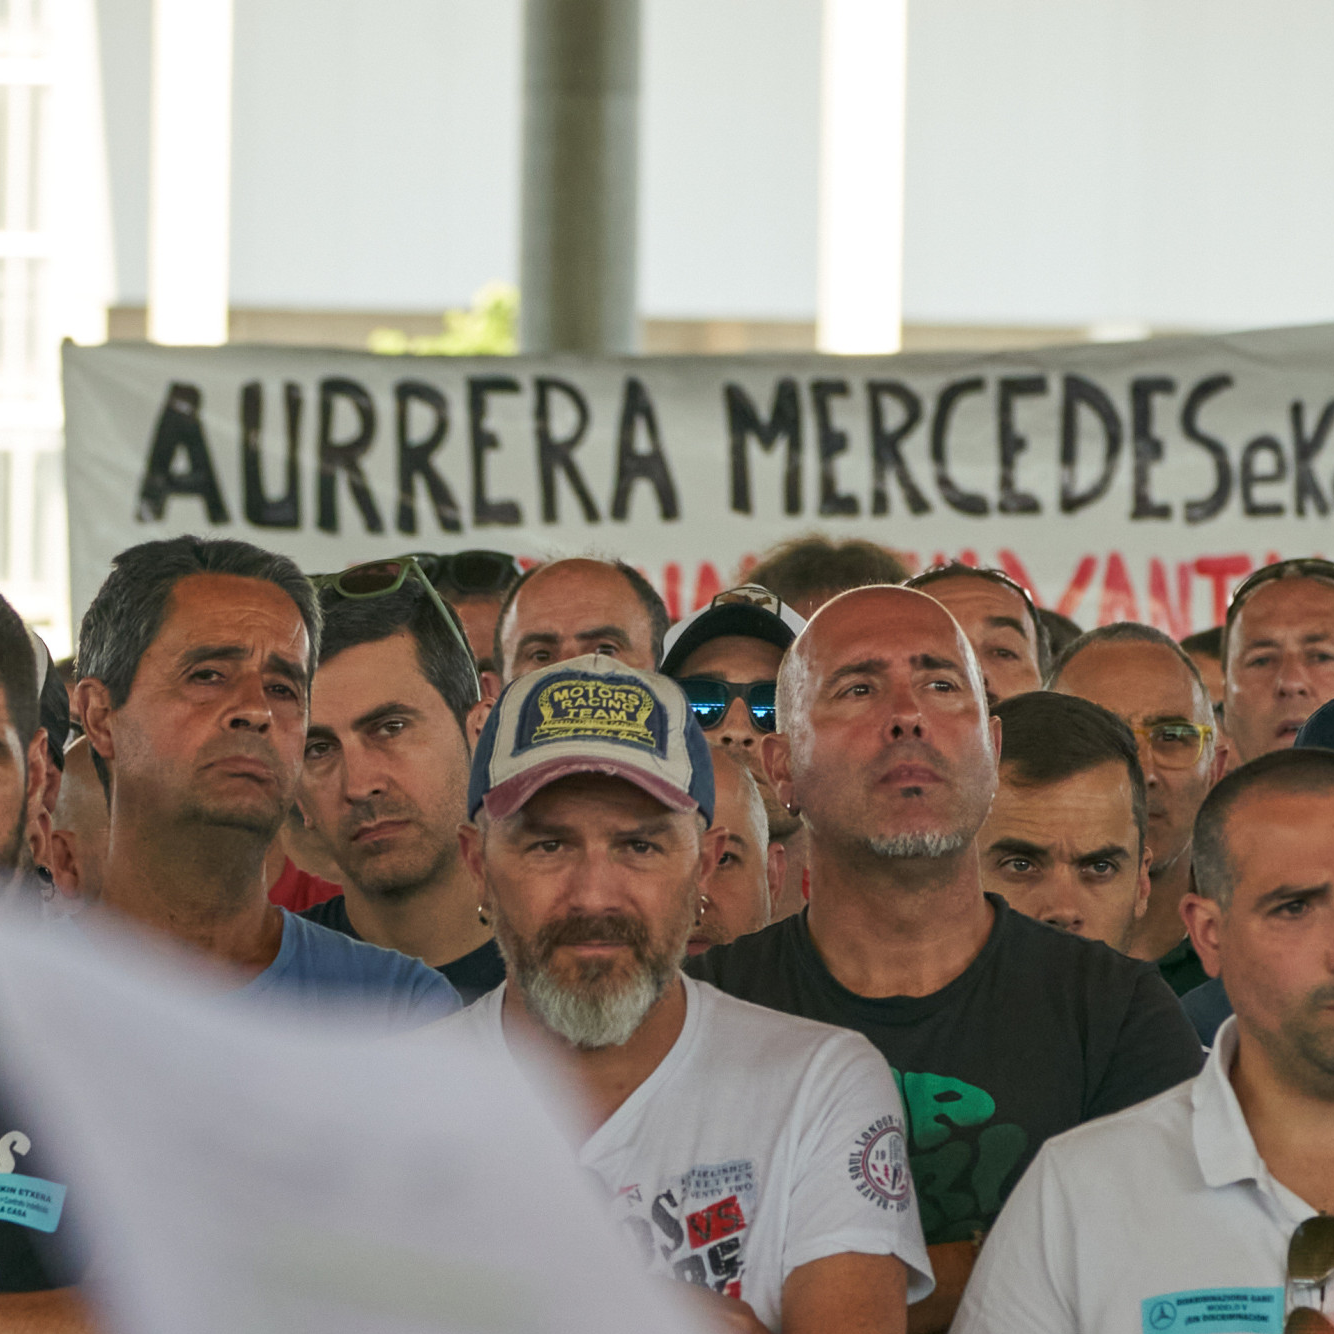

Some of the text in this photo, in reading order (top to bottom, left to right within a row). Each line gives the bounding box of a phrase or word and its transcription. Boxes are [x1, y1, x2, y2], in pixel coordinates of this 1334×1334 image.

[134, 374, 680, 535] AURRERA
[553, 686, 640, 706] MOTORS
[561, 697, 636, 713] RACING
[567, 708, 627, 721] TEAM
[854, 1114, 894, 1147] LONDON
[848, 1150, 864, 1181] SOUL
[689, 1202, 741, 1241] VS
